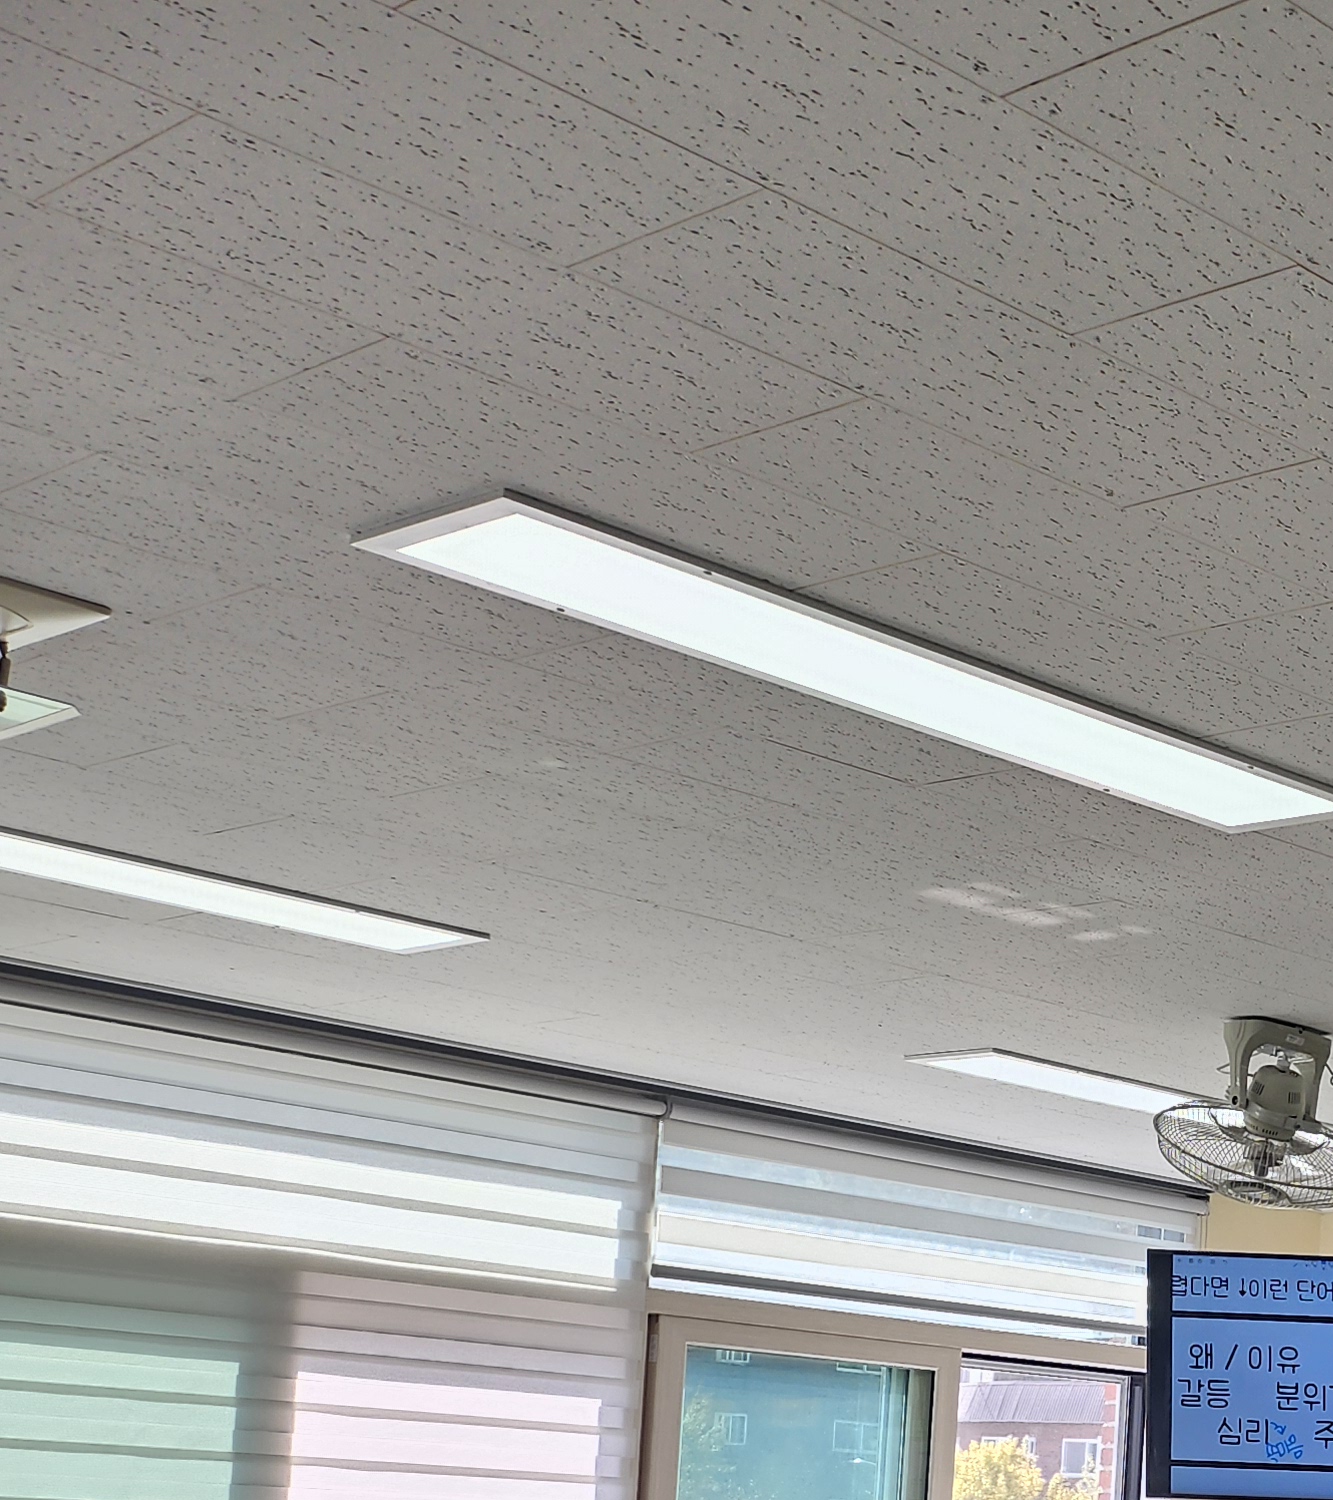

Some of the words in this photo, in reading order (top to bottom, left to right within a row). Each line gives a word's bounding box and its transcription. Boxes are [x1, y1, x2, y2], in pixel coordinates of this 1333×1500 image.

[1249, 1279, 1288, 1300] 이런
[1297, 1280, 1333, 1302] 단어
[1188, 1343, 1214, 1371] 왜
[1248, 1345, 1301, 1373] 이유
[1177, 1377, 1231, 1409] 갈등
[1217, 1418, 1270, 1446] 심리
